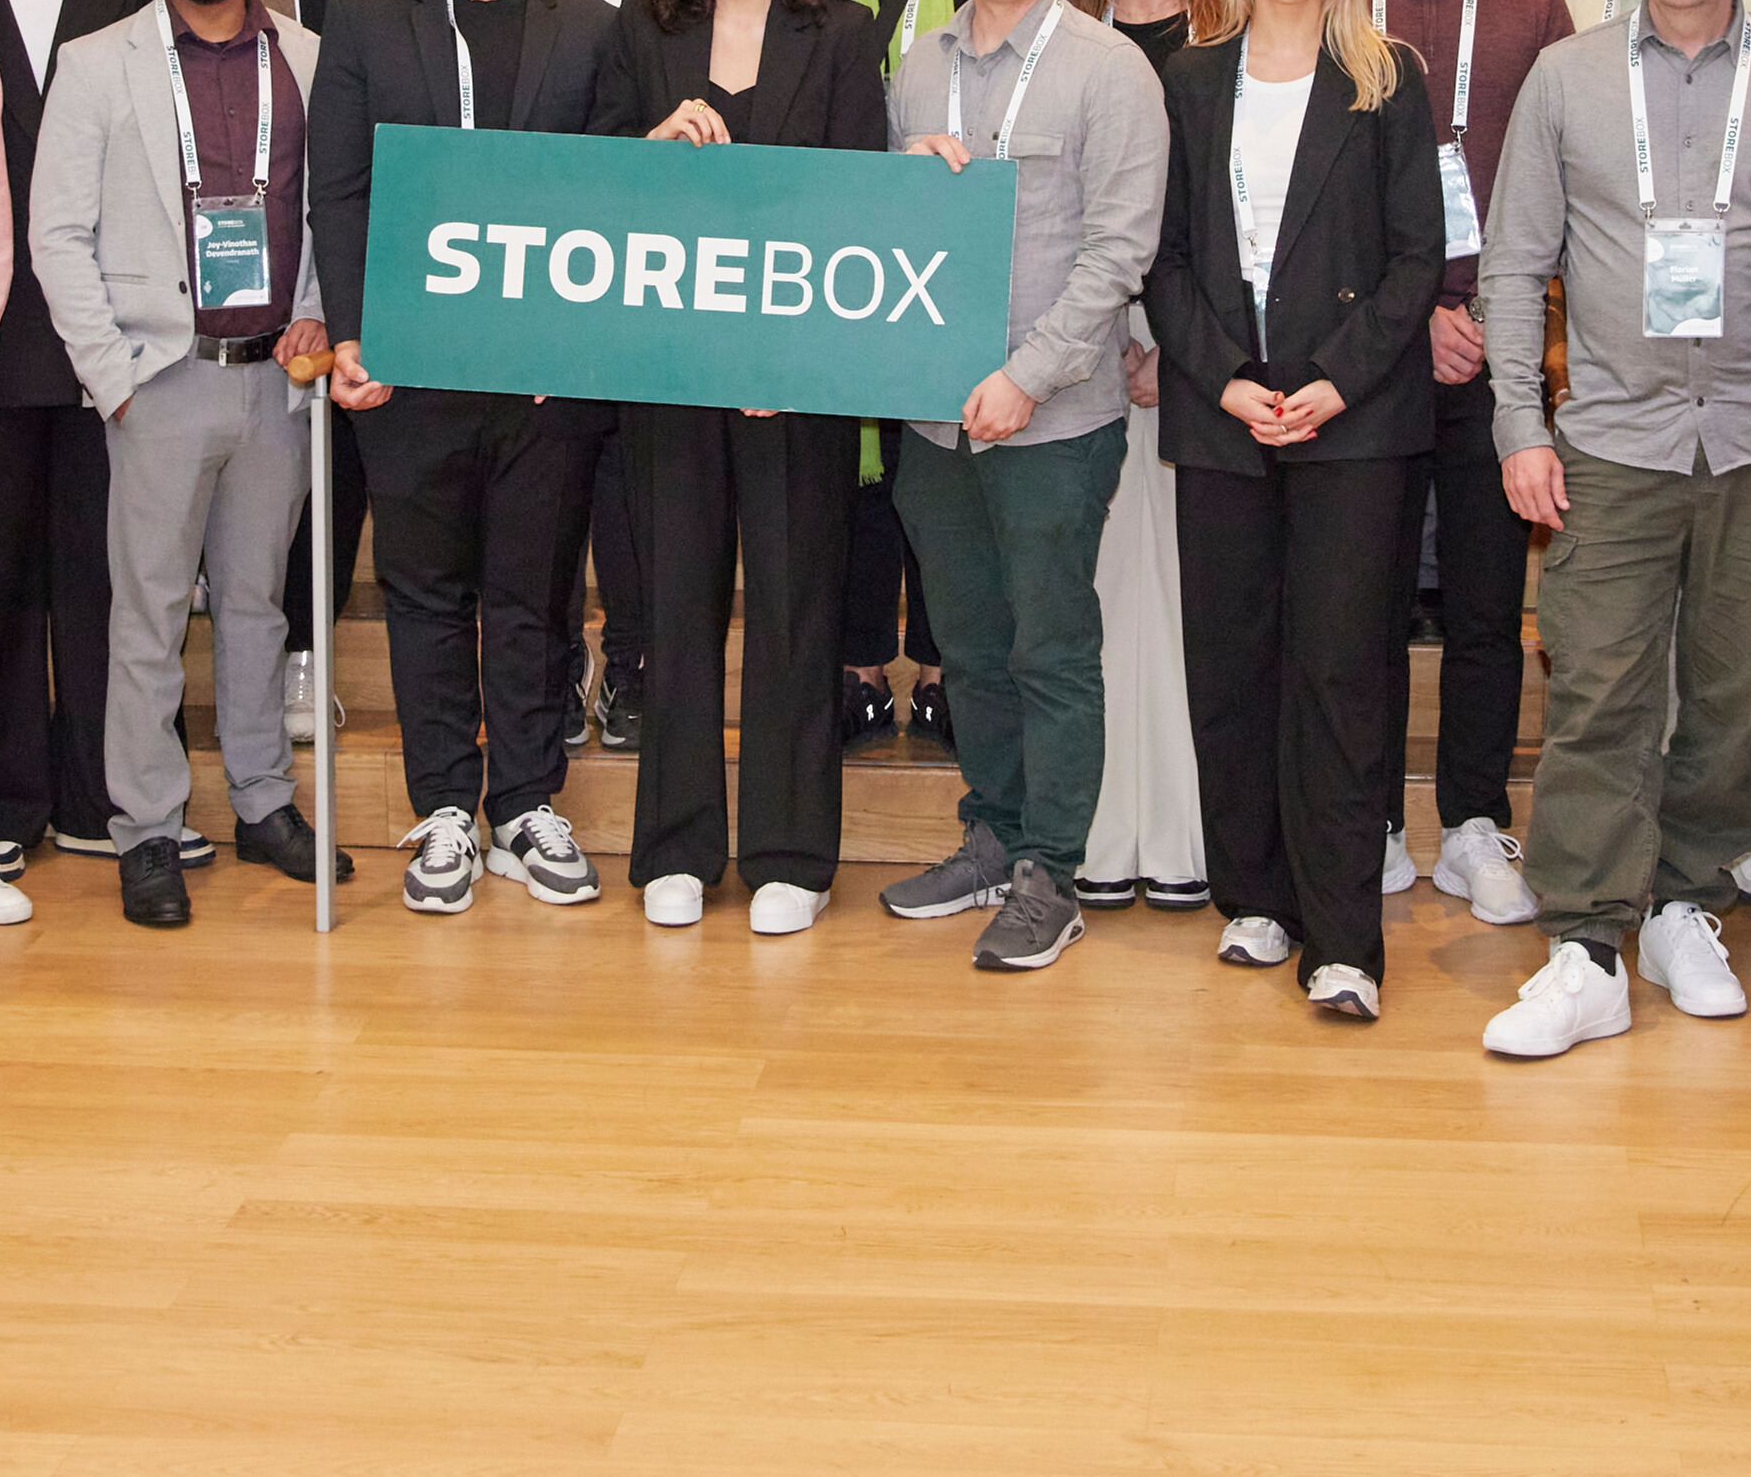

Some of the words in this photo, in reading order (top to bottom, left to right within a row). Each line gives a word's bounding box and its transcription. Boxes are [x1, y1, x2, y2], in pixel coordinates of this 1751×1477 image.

[166, 43, 184, 95] STOREBOX
[1020, 34, 1049, 83] STOREBOX
[1629, 19, 1640, 68] STOREBOX
[1739, 22, 1751, 69] STOREBOX
[460, 62, 472, 122] STOREBOX
[1234, 47, 1247, 100] STOREBOX
[1455, 62, 1468, 117] STOREBOX
[258, 101, 270, 156] STOREBOX
[1636, 116, 1650, 174] STOREBOX
[1723, 116, 1738, 174] STOREBOX
[1231, 146, 1248, 204] STOREBOX
[206, 239, 259, 251] Joy-Vinothan
[425, 221, 950, 326] STOREBOX
